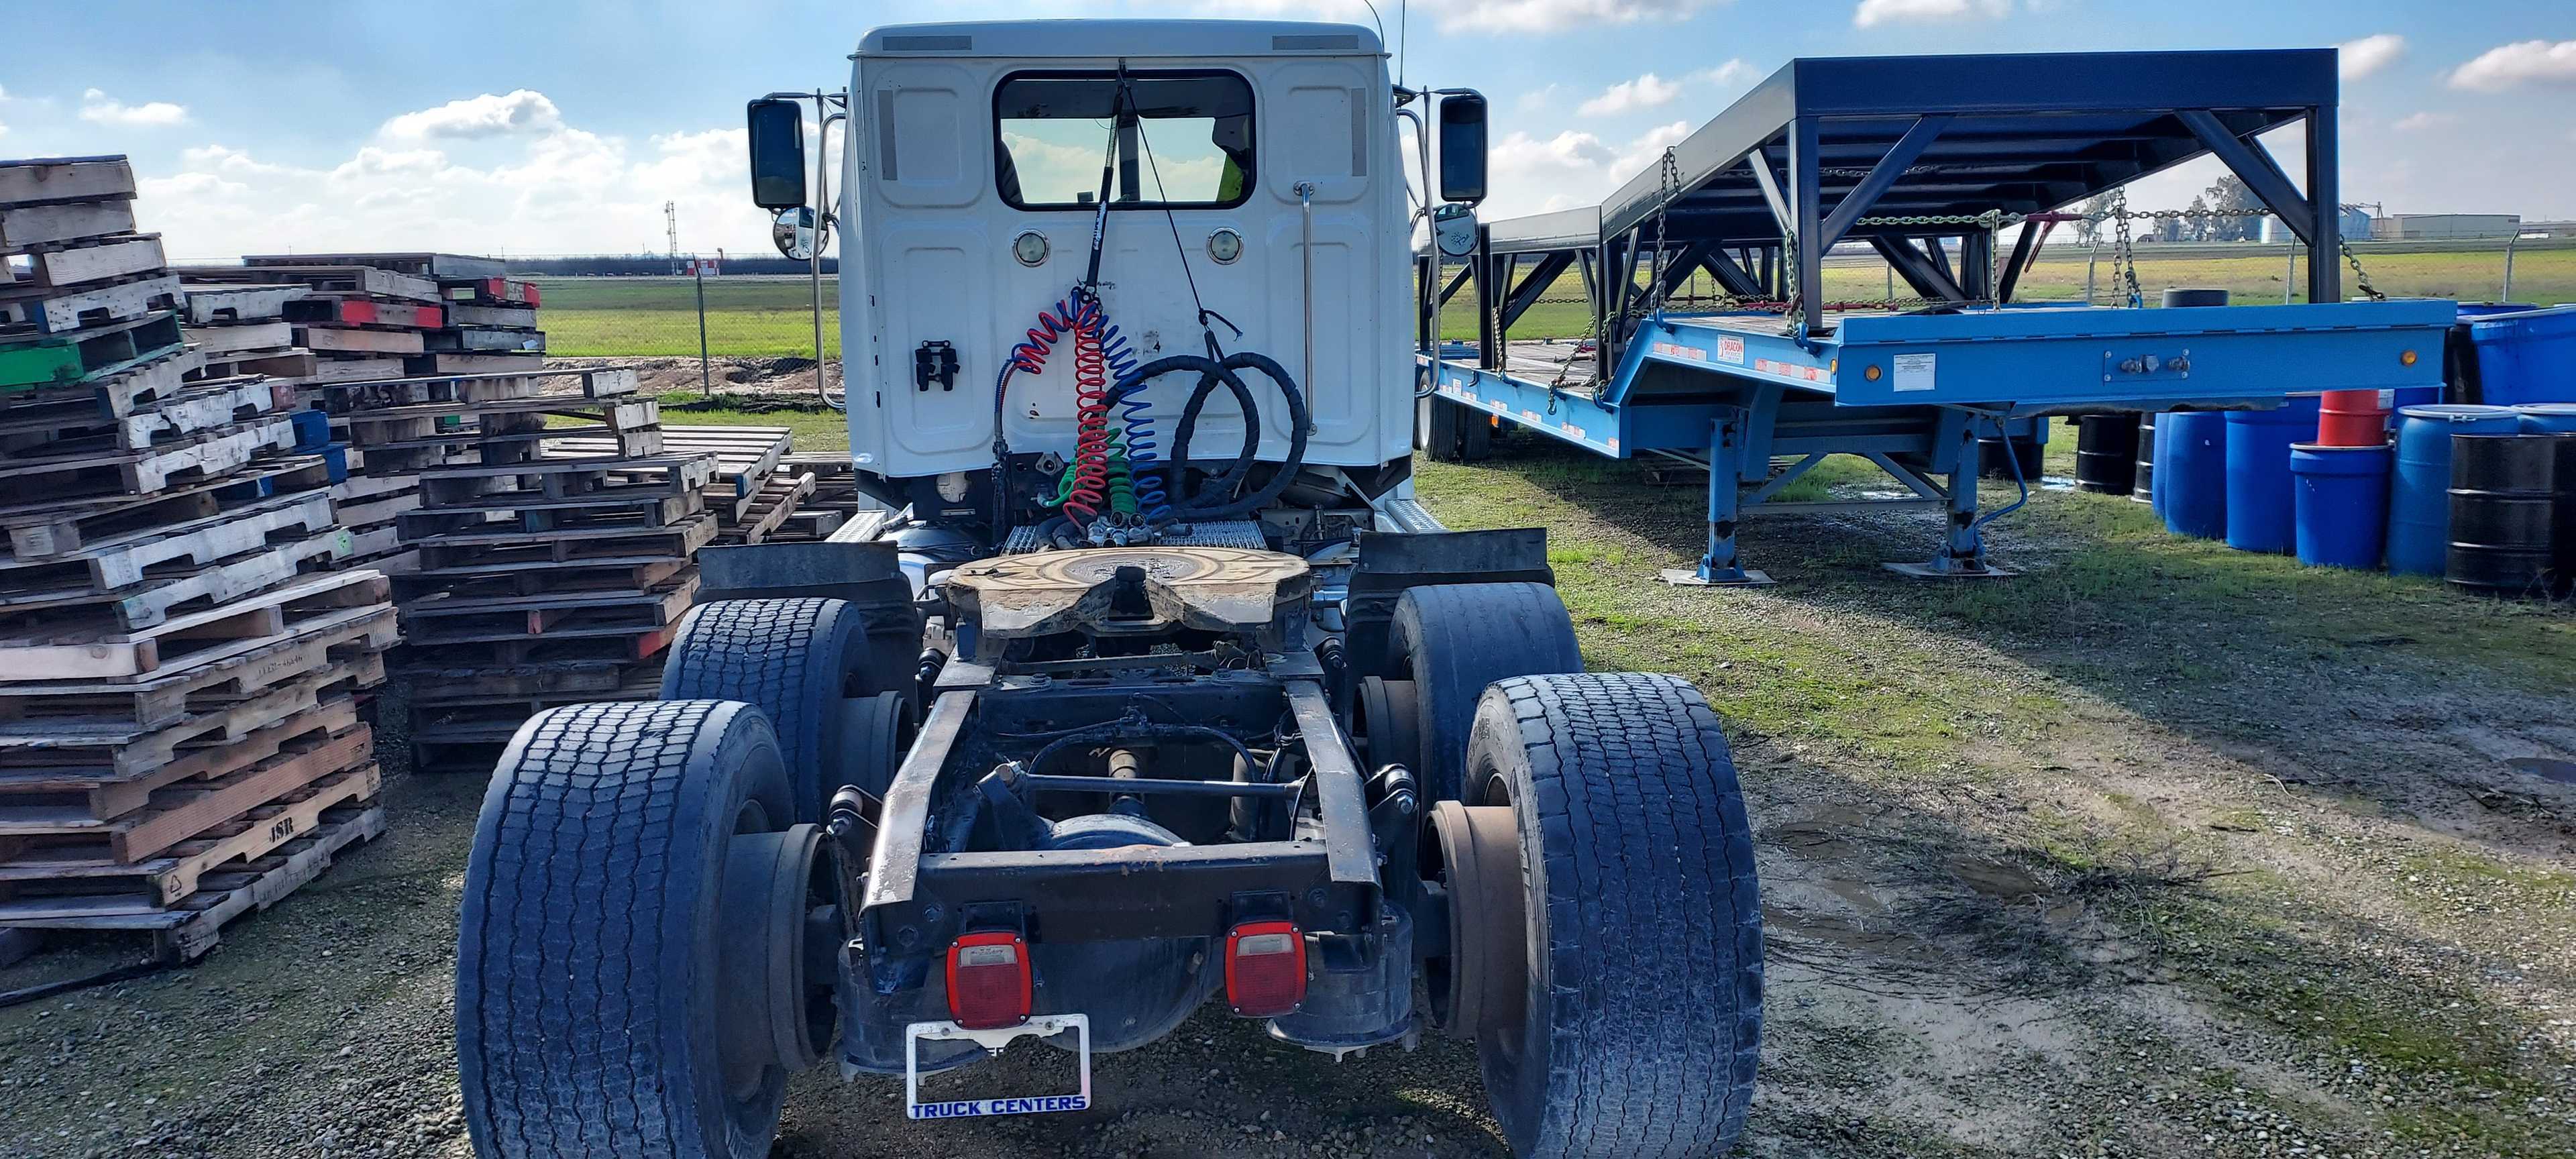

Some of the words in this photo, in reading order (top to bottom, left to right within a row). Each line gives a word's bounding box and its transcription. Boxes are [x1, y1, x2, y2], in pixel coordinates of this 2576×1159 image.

[269, 817, 294, 842] JSR
[912, 1101, 982, 1118] TRUCK
[991, 1096, 1086, 1113] CENTERS
